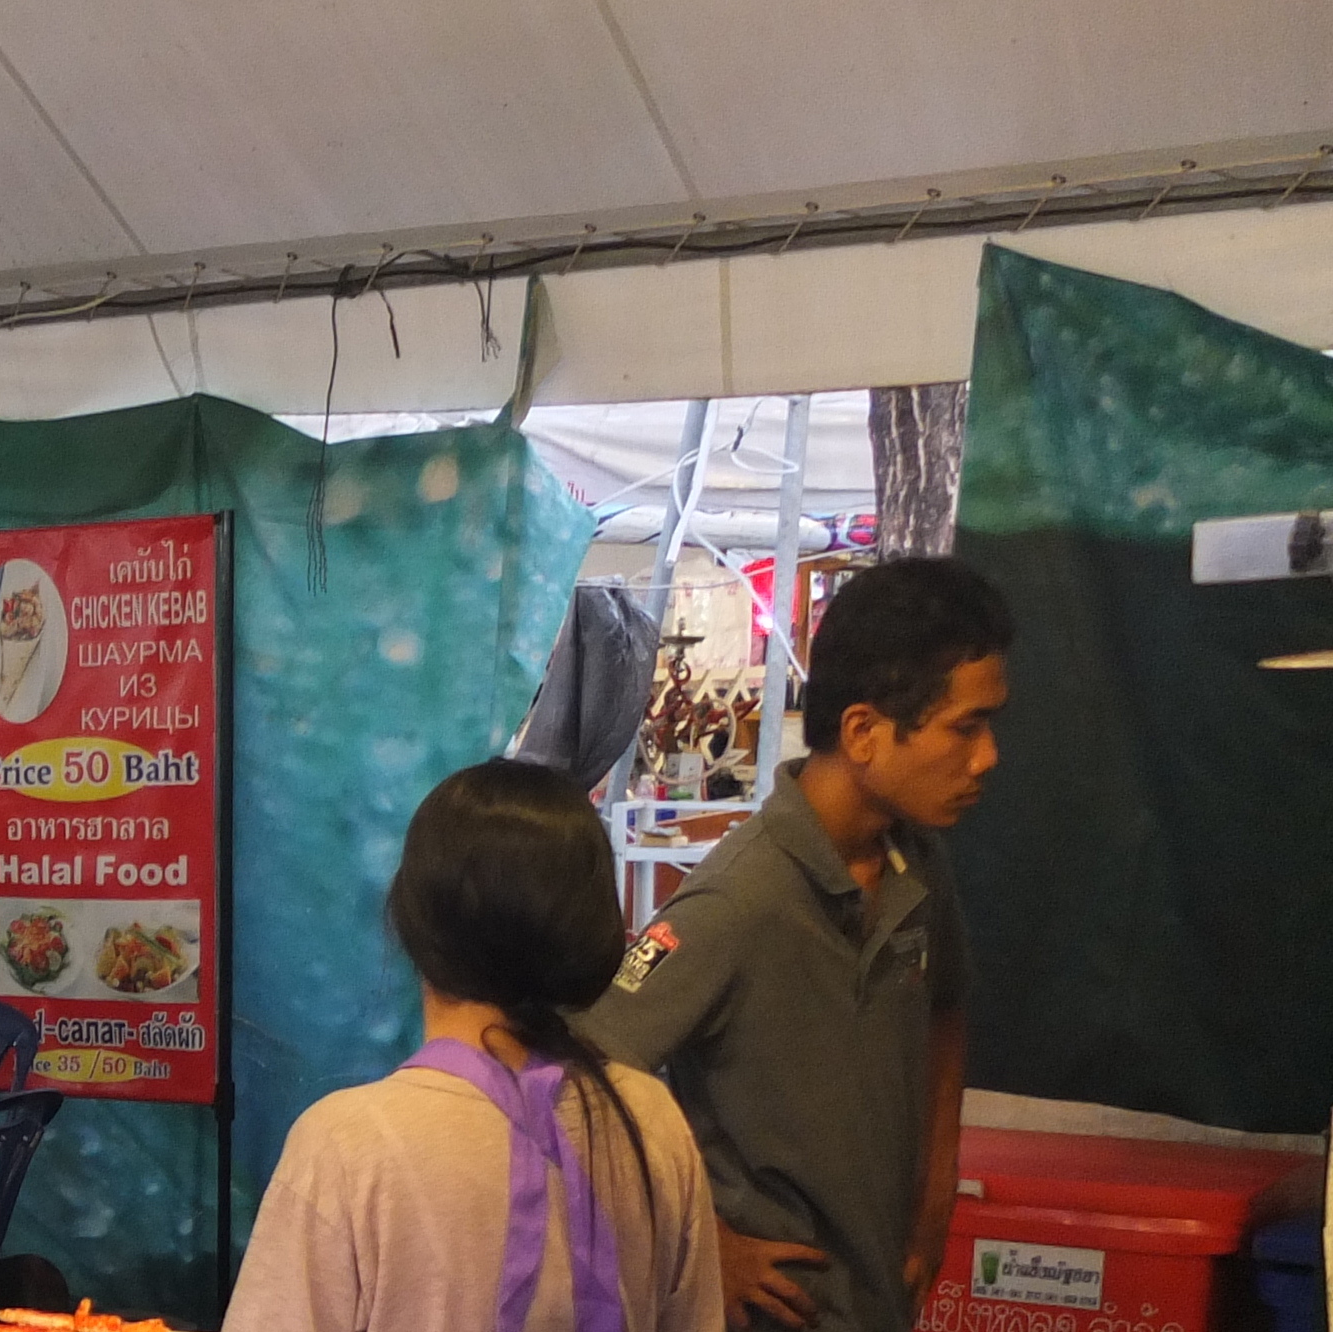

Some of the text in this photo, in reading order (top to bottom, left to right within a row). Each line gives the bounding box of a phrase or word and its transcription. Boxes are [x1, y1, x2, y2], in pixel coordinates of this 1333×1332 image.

[71, 589, 207, 630] CHICKEN KEBAB
[79, 638, 203, 667] ШАУРМА
[120, 673, 158, 698] ИЗ
[81, 704, 199, 735] КУРИЦЫ
[64, 750, 110, 784] 50
[122, 751, 198, 784] Baht
[7, 816, 170, 841] อาหารฮาลาล
[95, 854, 188, 887] Food
[57, 1054, 81, 1073] 35
[134, 1059, 171, 1080] Baht
